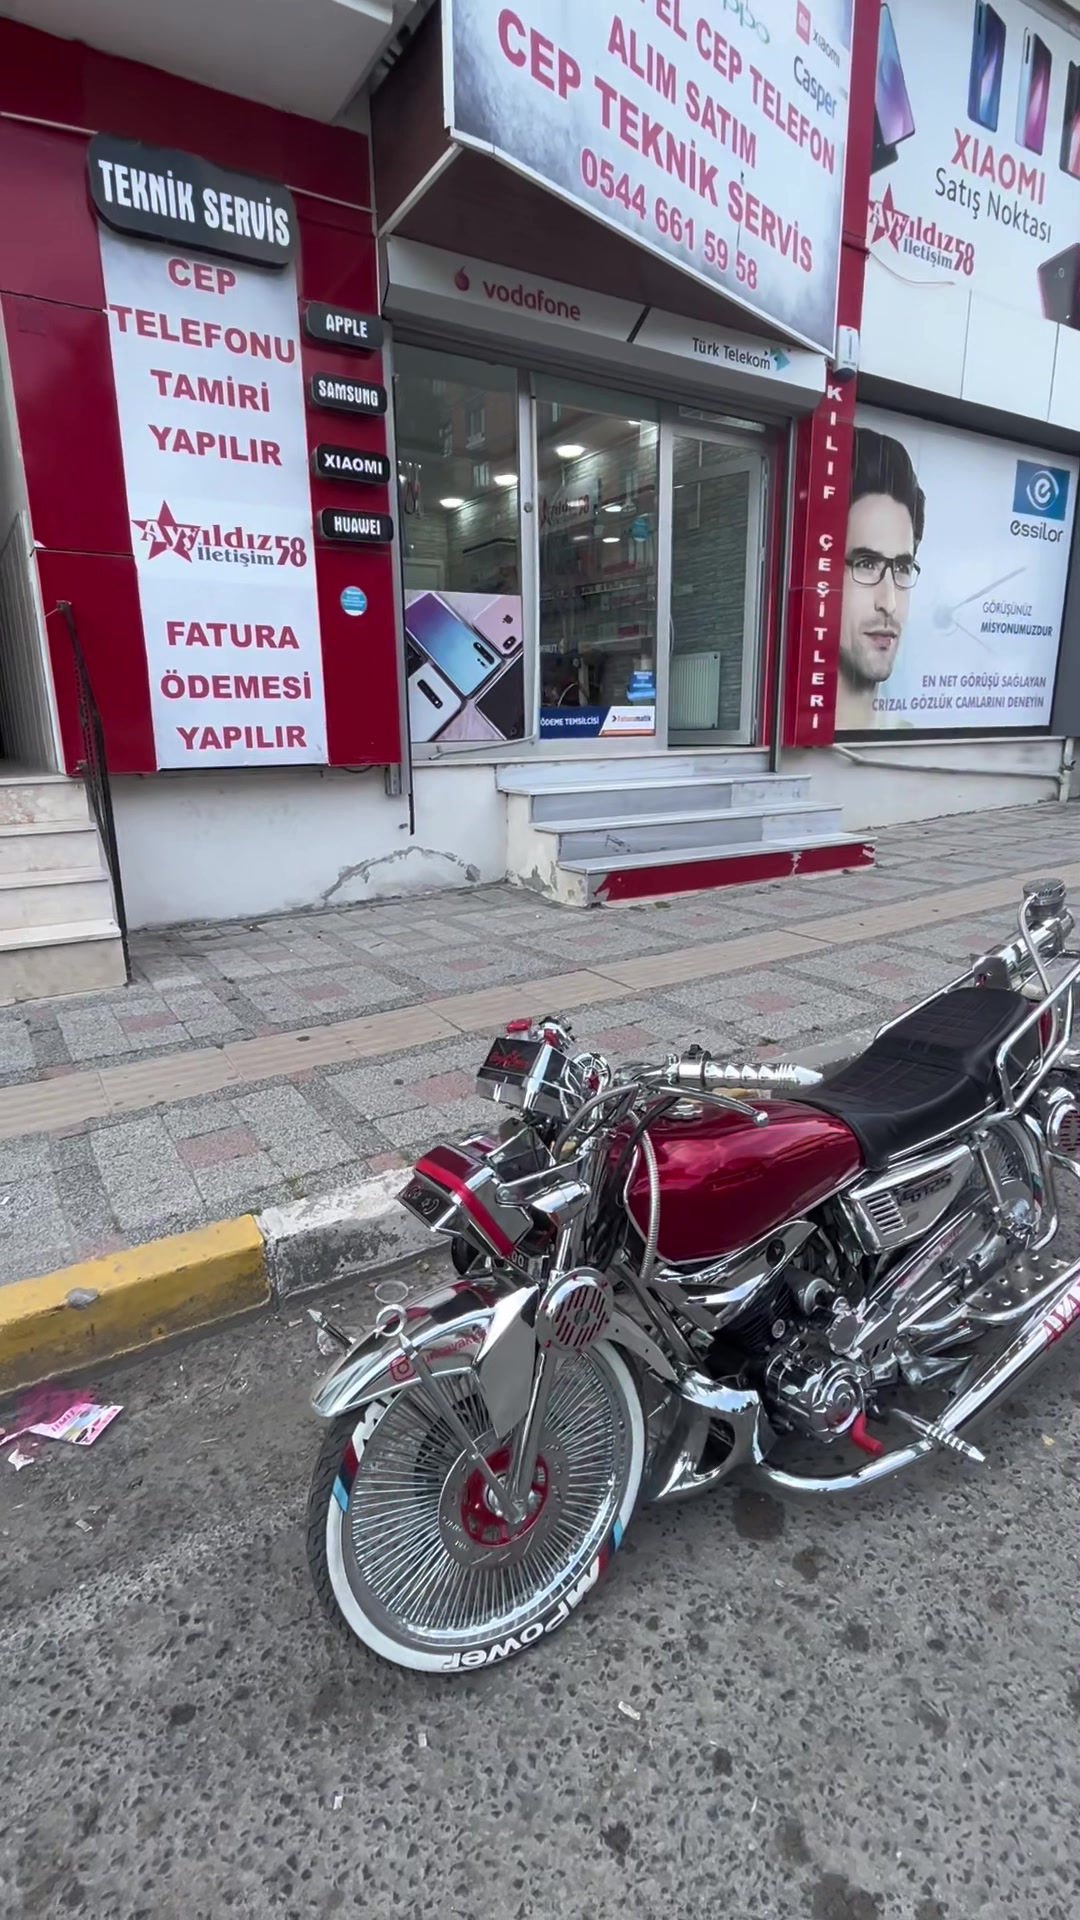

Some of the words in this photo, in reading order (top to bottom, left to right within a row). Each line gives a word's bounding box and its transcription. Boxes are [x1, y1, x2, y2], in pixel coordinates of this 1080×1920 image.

[608, 15, 677, 105] ALIM
[685, 80, 757, 169] SATIM
[696, 18, 742, 84] CEP
[750, 64, 835, 175] TELEFON
[794, 56, 837, 119] Casper
[497, 9, 581, 100] CEP
[594, 75, 718, 207] TEKNİK
[728, 181, 813, 273] SERVİS
[951, 128, 1046, 205] XIAOMI
[98, 159, 195, 222] TEKNİK
[202, 187, 291, 247] SERVİS
[581, 148, 647, 220] 0544
[655, 197, 695, 251] 661
[704, 229, 728, 271] 59
[735, 250, 758, 290] 58
[935, 167, 981, 220] Satış
[987, 191, 1052, 243] Noktası
[168, 258, 236, 295] CEP
[482, 280, 582, 321] vodafone
[109, 304, 296, 364] TELEFONU
[326, 313, 368, 339] APPLE
[692, 337, 720, 357] Türk
[723, 345, 771, 370] Telekom
[150, 369, 271, 412] TAMİRİ
[318, 379, 378, 407] SAMSUNG
[148, 424, 283, 466] YAPILIR
[823, 385, 842, 500] KILIF
[324, 453, 383, 475] XIAOMI
[334, 516, 381, 536] HUAWEI
[1010, 520, 1064, 544] essilor
[983, 600, 1032, 617] GÖRÜŞÜNÜZ
[166, 621, 300, 649] FATURA
[810, 534, 833, 729] ÇEŞİTLERİ
[981, 619, 1053, 637] MİSYONUMUZDUR
[160, 669, 312, 700] ÖDEMESİ
[922, 675, 936, 687] EN
[939, 675, 958, 687] NET
[960, 673, 1000, 690] GÖRÜŞÜ
[1001, 673, 1047, 688] SAĞLAYAN
[872, 698, 908, 711] CRIZAL
[910, 694, 953, 710] GÖZLÜK
[955, 696, 1006, 709] CAMLARINI
[1007, 694, 1044, 708] DENEYİN
[176, 726, 307, 750] YAPILIR
[540, 717, 564, 726] ÖDEME
